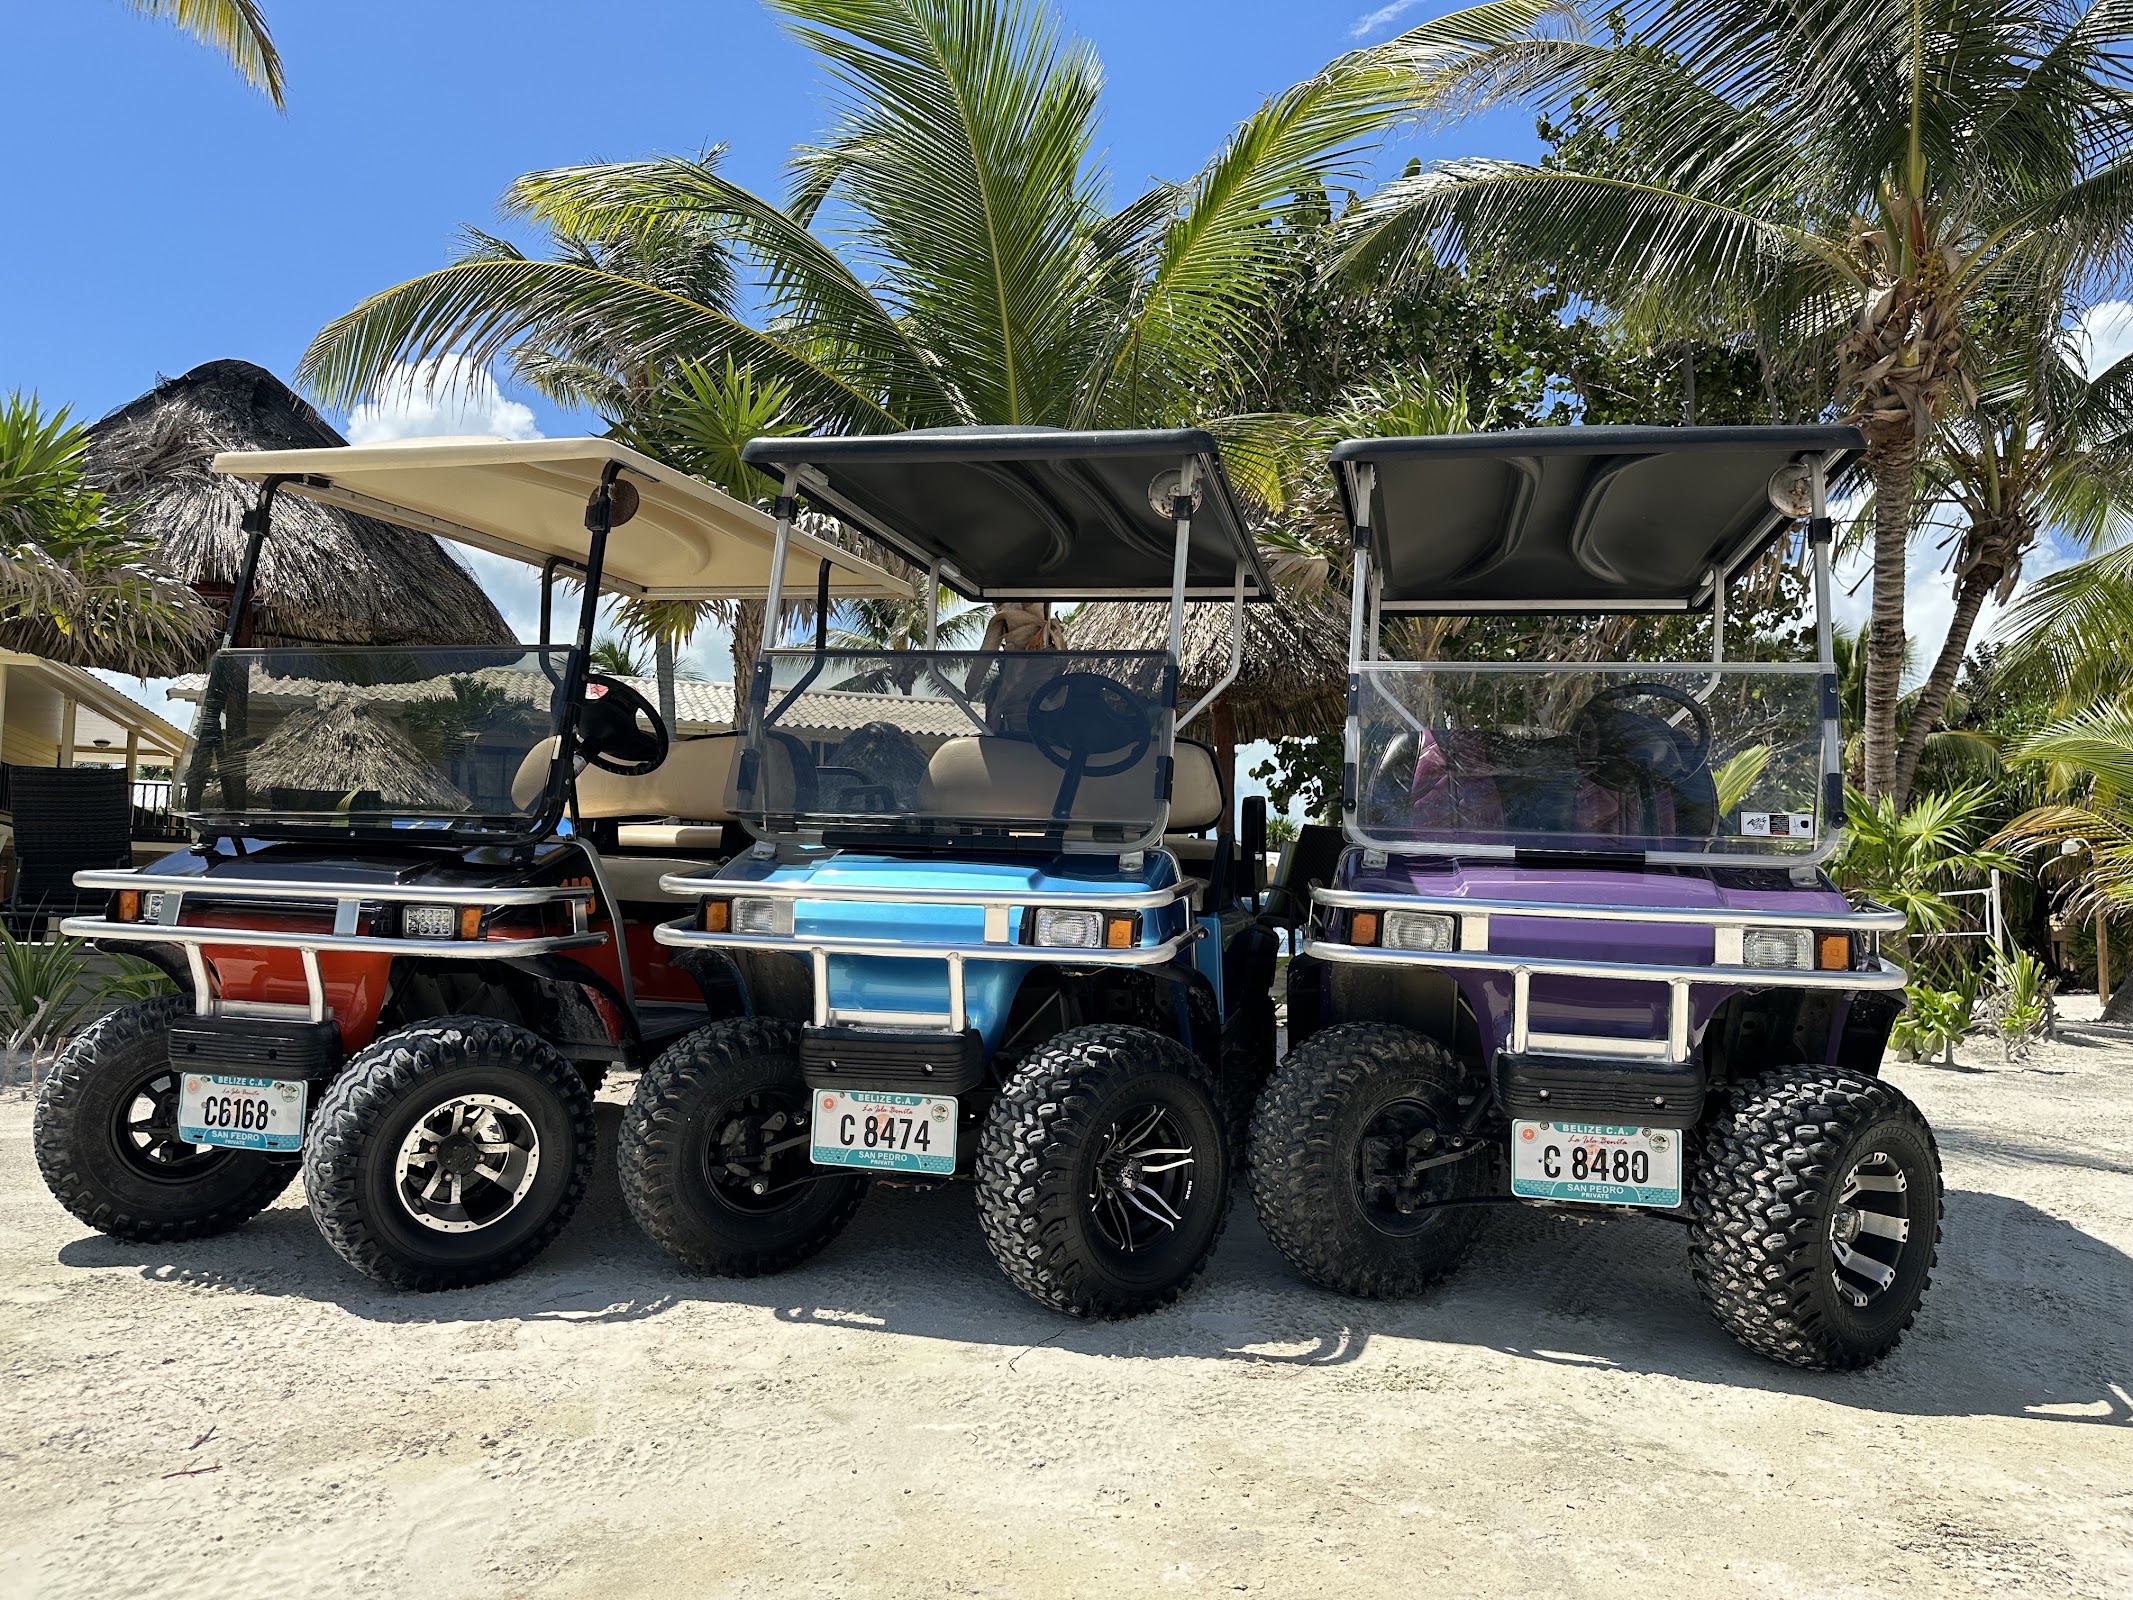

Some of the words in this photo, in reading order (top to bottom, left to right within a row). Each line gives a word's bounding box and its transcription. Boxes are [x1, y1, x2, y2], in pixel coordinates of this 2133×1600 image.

[217, 1075, 247, 1086] BELIZE
[248, 1077, 267, 1087] C.A.
[858, 1093, 892, 1104] BELIZE
[895, 1095, 915, 1106] C.A.
[204, 1096, 269, 1131] C6168
[862, 1104, 873, 1112] La
[889, 1105, 914, 1115] Bonita
[211, 1130, 229, 1139] SAN
[840, 1113, 856, 1146] C
[864, 1115, 931, 1152] 8474
[1562, 1124, 1602, 1135] BELIZE
[1605, 1126, 1629, 1136] C.A.
[1568, 1134, 1580, 1143] La
[1582, 1135, 1598, 1144] Isla
[1600, 1136, 1628, 1146] Bonita
[858, 1150, 876, 1160] SAN
[877, 1152, 908, 1162] PEDRO
[1543, 1145, 1561, 1179] C
[1572, 1146, 1649, 1184] 8480
[1567, 1183, 1588, 1192] SAN
[1589, 1184, 1624, 1195] PEDRO
[1581, 1191, 1610, 1200] PRIVATE
